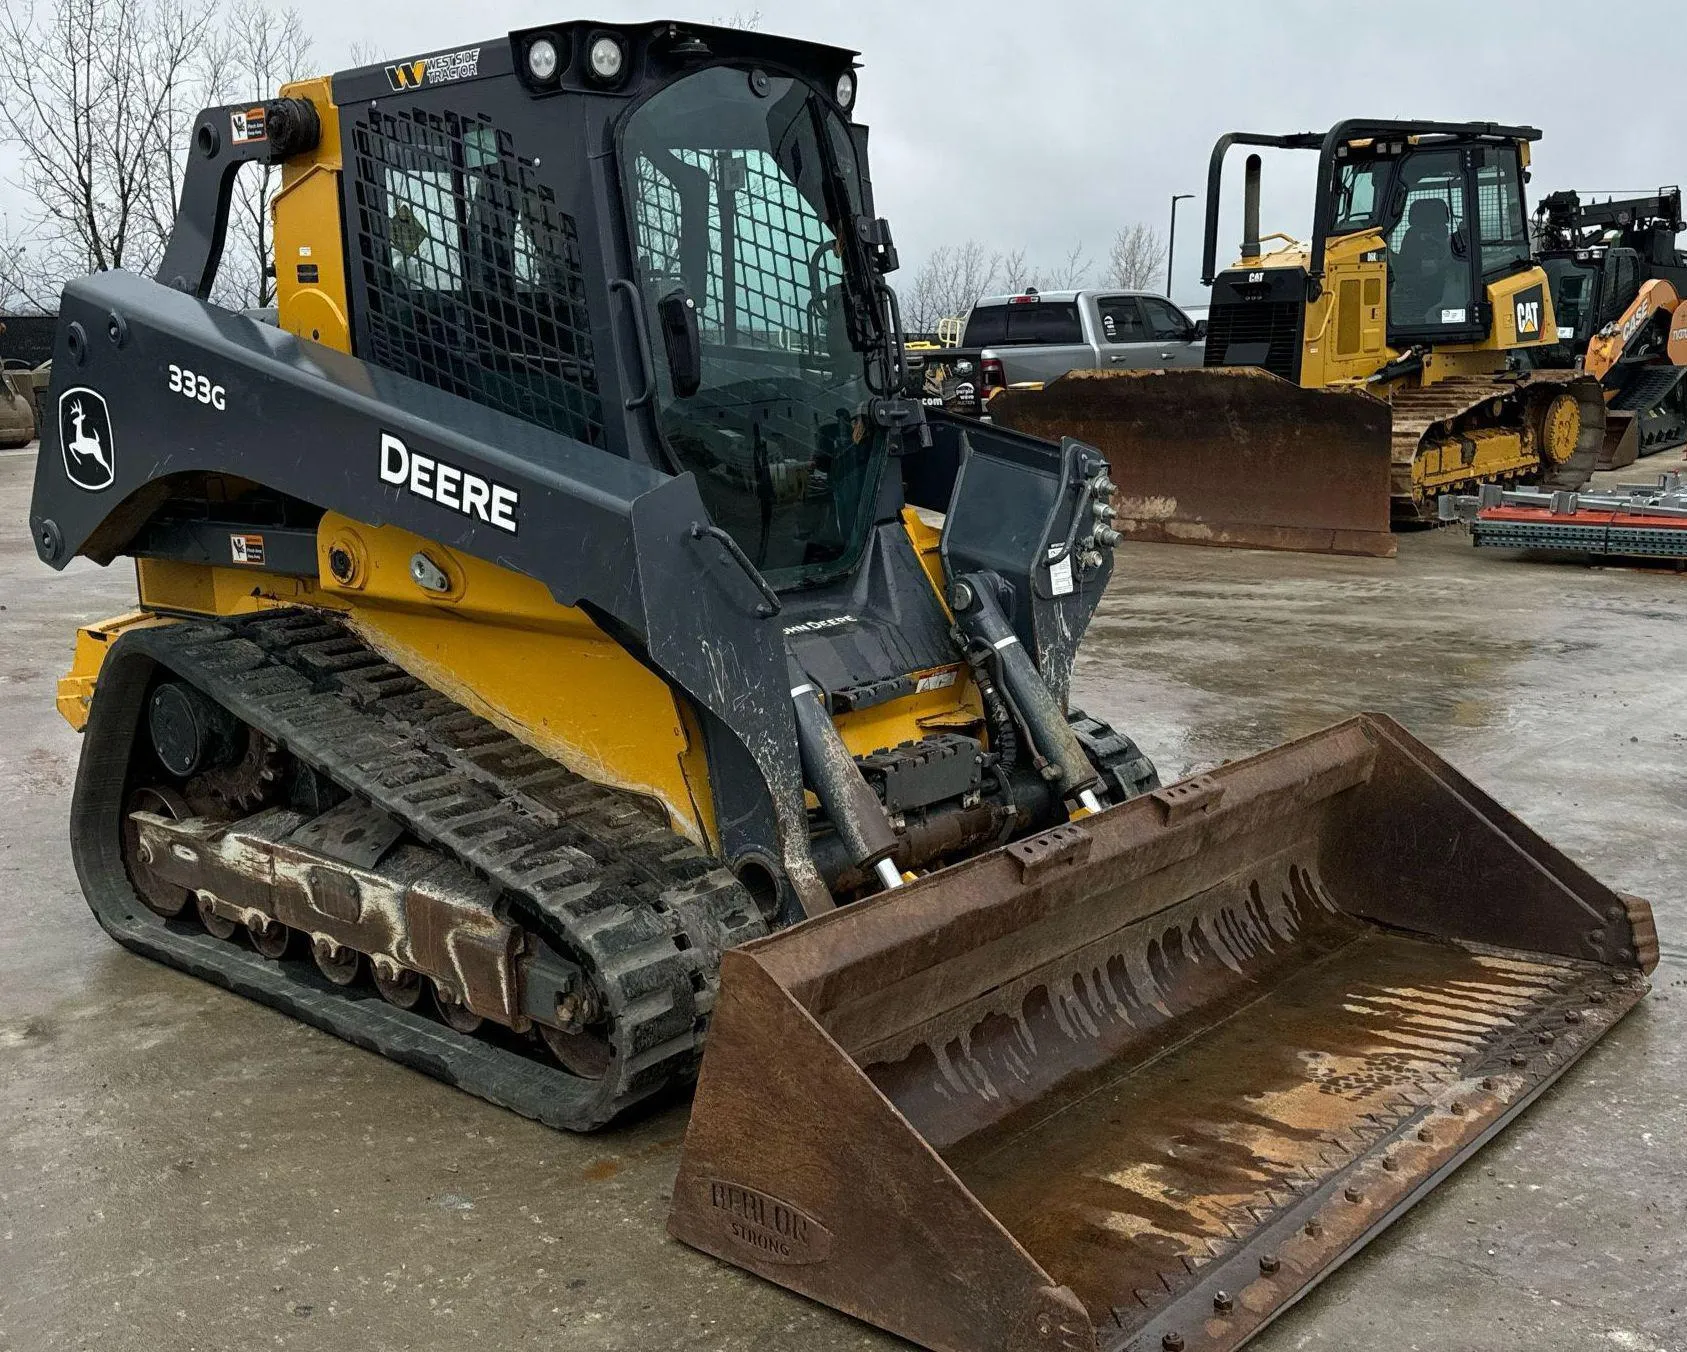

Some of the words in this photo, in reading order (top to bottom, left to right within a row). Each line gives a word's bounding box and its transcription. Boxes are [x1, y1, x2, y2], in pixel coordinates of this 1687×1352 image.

[455, 48, 480, 62] SIDE
[427, 63, 478, 83] TRACTOR
[1248, 272, 1264, 283] CAT
[1516, 302, 1539, 333] CAT
[1622, 298, 1649, 341] CASE
[168, 364, 226, 411] 333G
[379, 432, 518, 533] DEERE
[806, 614, 858, 629] DEERE
[731, 1221, 792, 1257] STRONG
